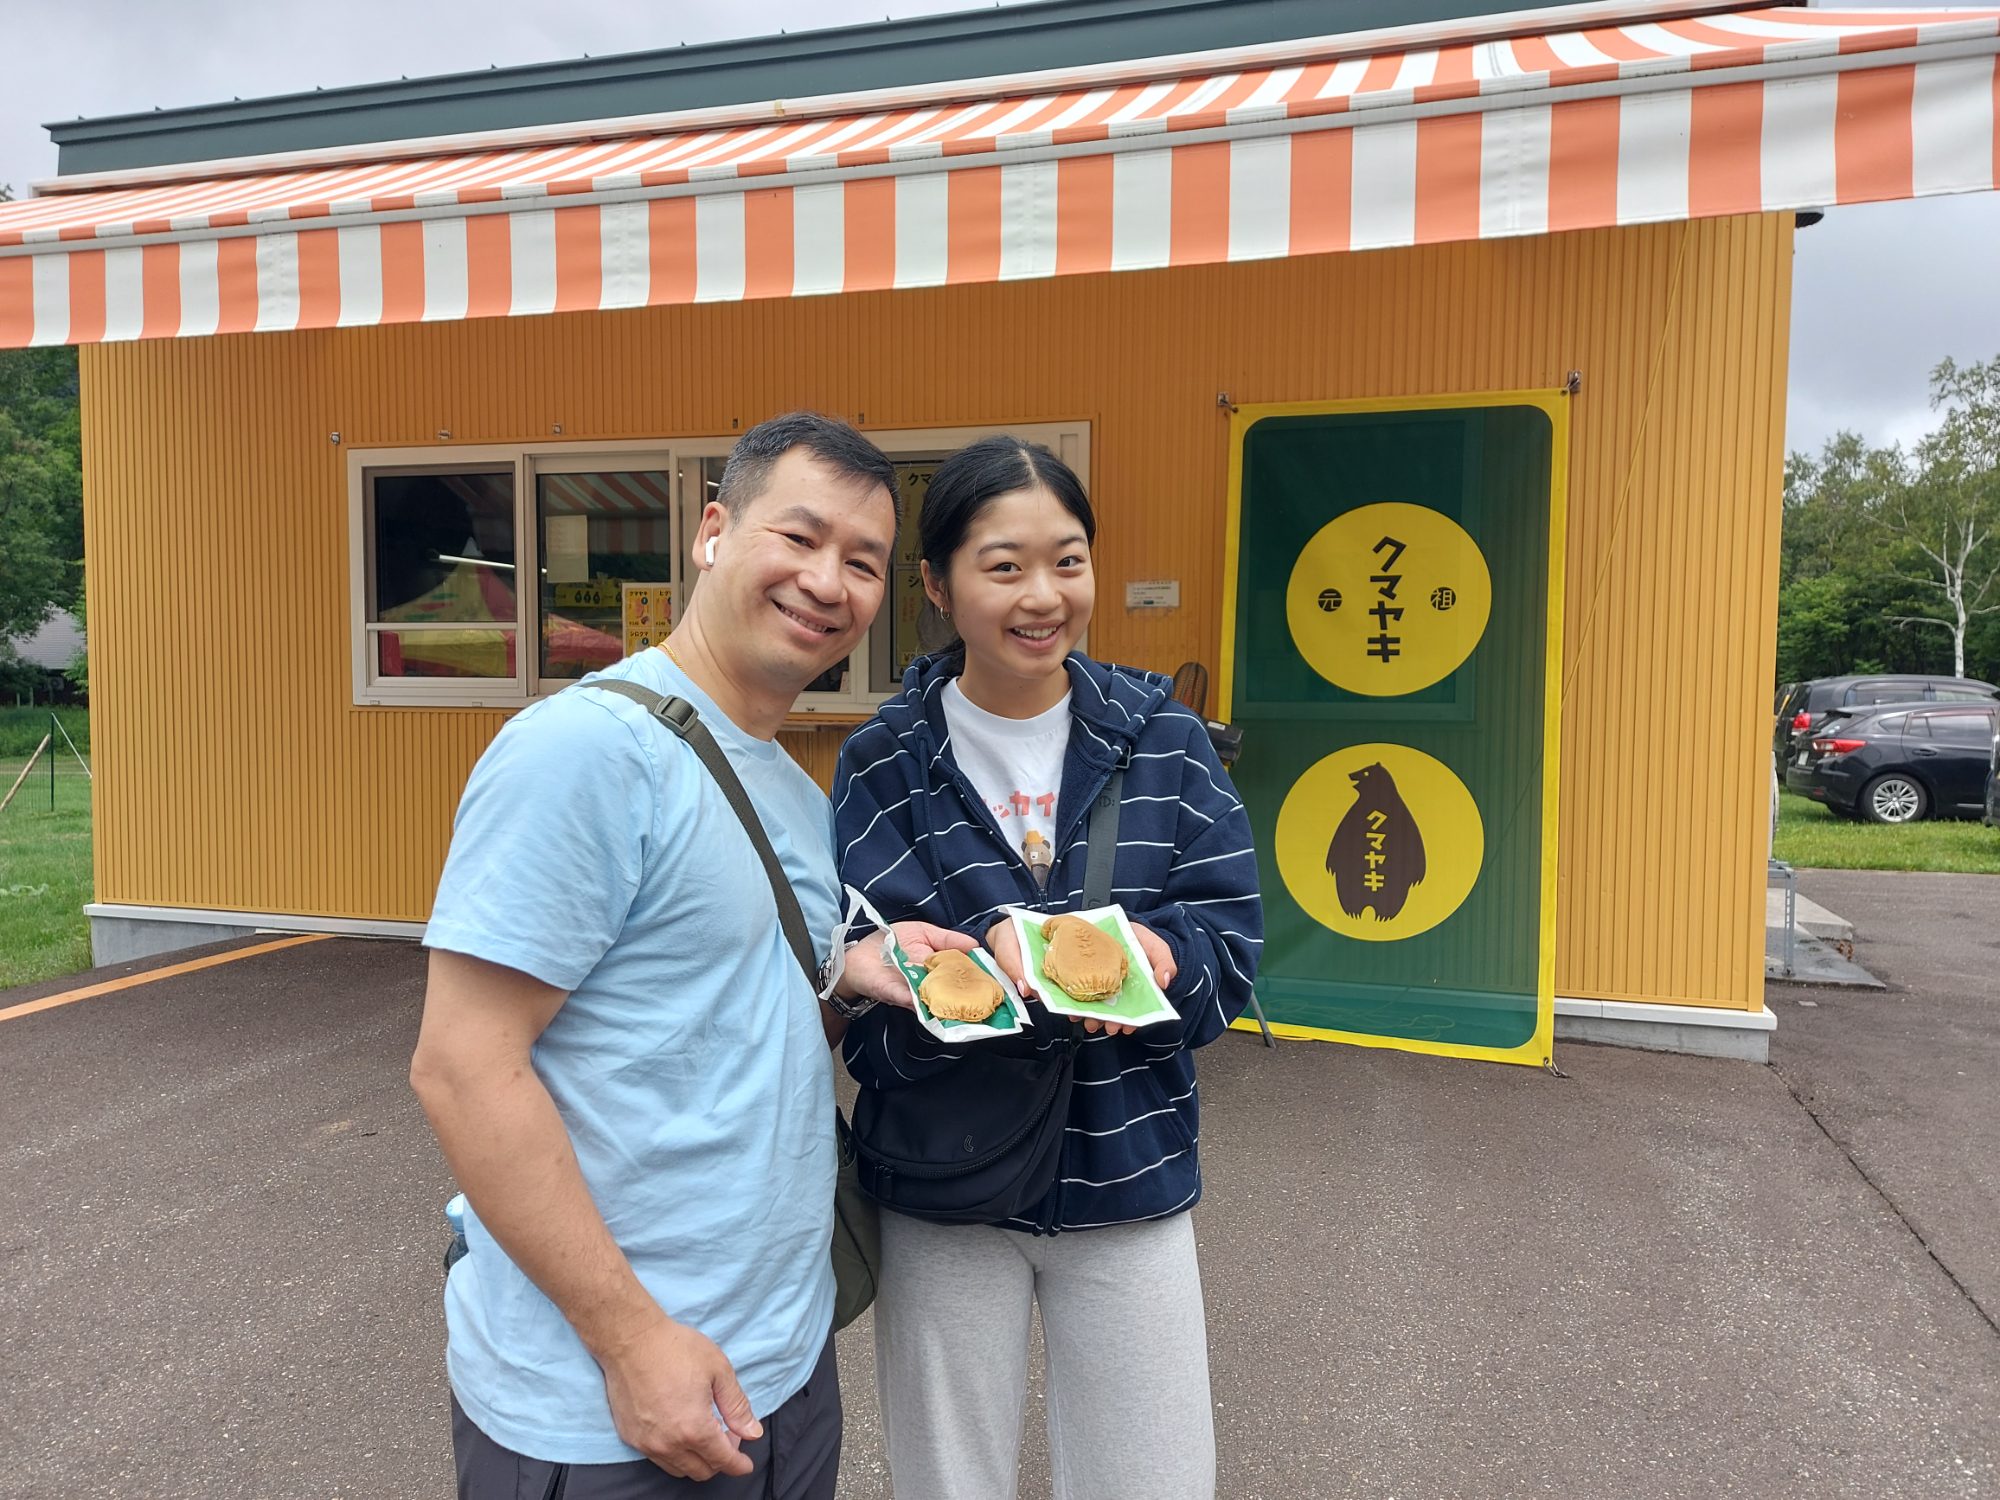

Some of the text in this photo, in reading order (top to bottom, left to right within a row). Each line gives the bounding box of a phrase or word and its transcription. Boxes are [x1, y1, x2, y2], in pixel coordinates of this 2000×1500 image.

[1318, 588, 1342, 612] 元
[1367, 535, 1407, 663] クマヤキ
[1431, 586, 1456, 611] 祖
[982, 790, 1056, 818] ッカイ
[1364, 809, 1388, 892] クマヤキ
